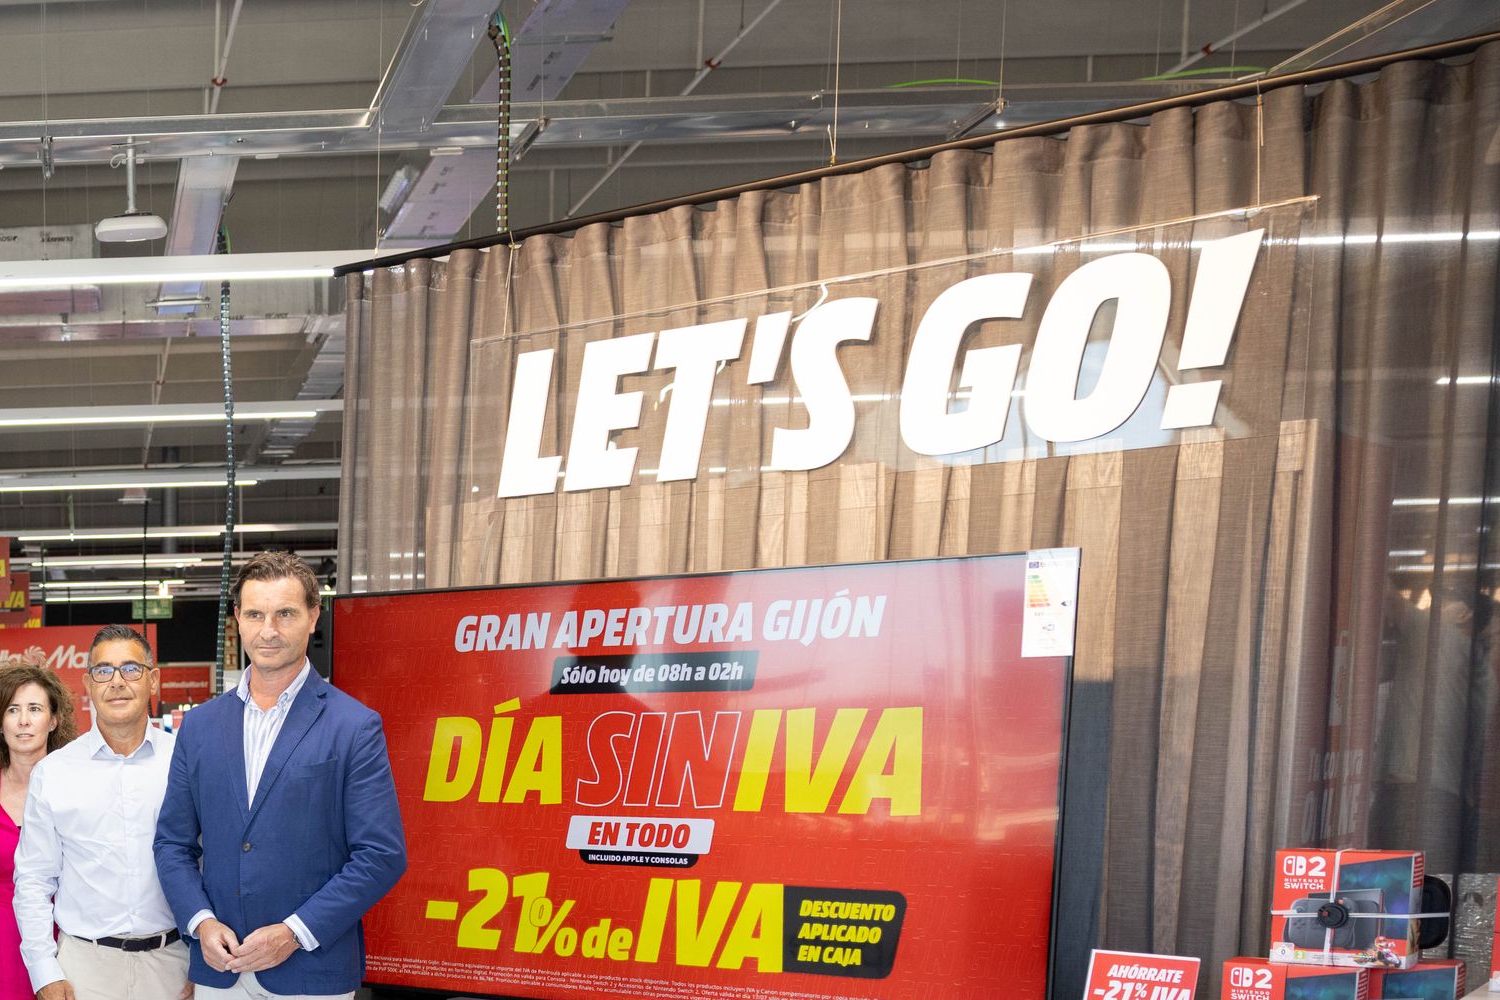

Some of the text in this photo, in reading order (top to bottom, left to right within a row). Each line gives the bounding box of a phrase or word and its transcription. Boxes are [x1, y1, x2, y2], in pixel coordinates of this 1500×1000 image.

[498, 228, 1264, 499] LET'S GO!
[454, 589, 887, 653] GRAN APERTURA GIJÓN
[561, 661, 745, 687] Sólo hoy de 08h a 02h
[423, 697, 924, 816] DÍA SIN IVA
[587, 821, 691, 849] EN TODO
[588, 853, 621, 863] INCLUIDO
[621, 854, 644, 864] APPLE
[650, 856, 688, 866] CONSOLAS
[1308, 856, 1326, 876] 2
[1284, 882, 1324, 890] SWITCH
[425, 868, 784, 974] -21% de IVA
[799, 899, 896, 923] DESCUENTO
[798, 924, 882, 945] APLICADO
[797, 945, 862, 968] EN CAJA
[1107, 964, 1184, 984] AHÓRRATE
[1255, 969, 1272, 989] 2
